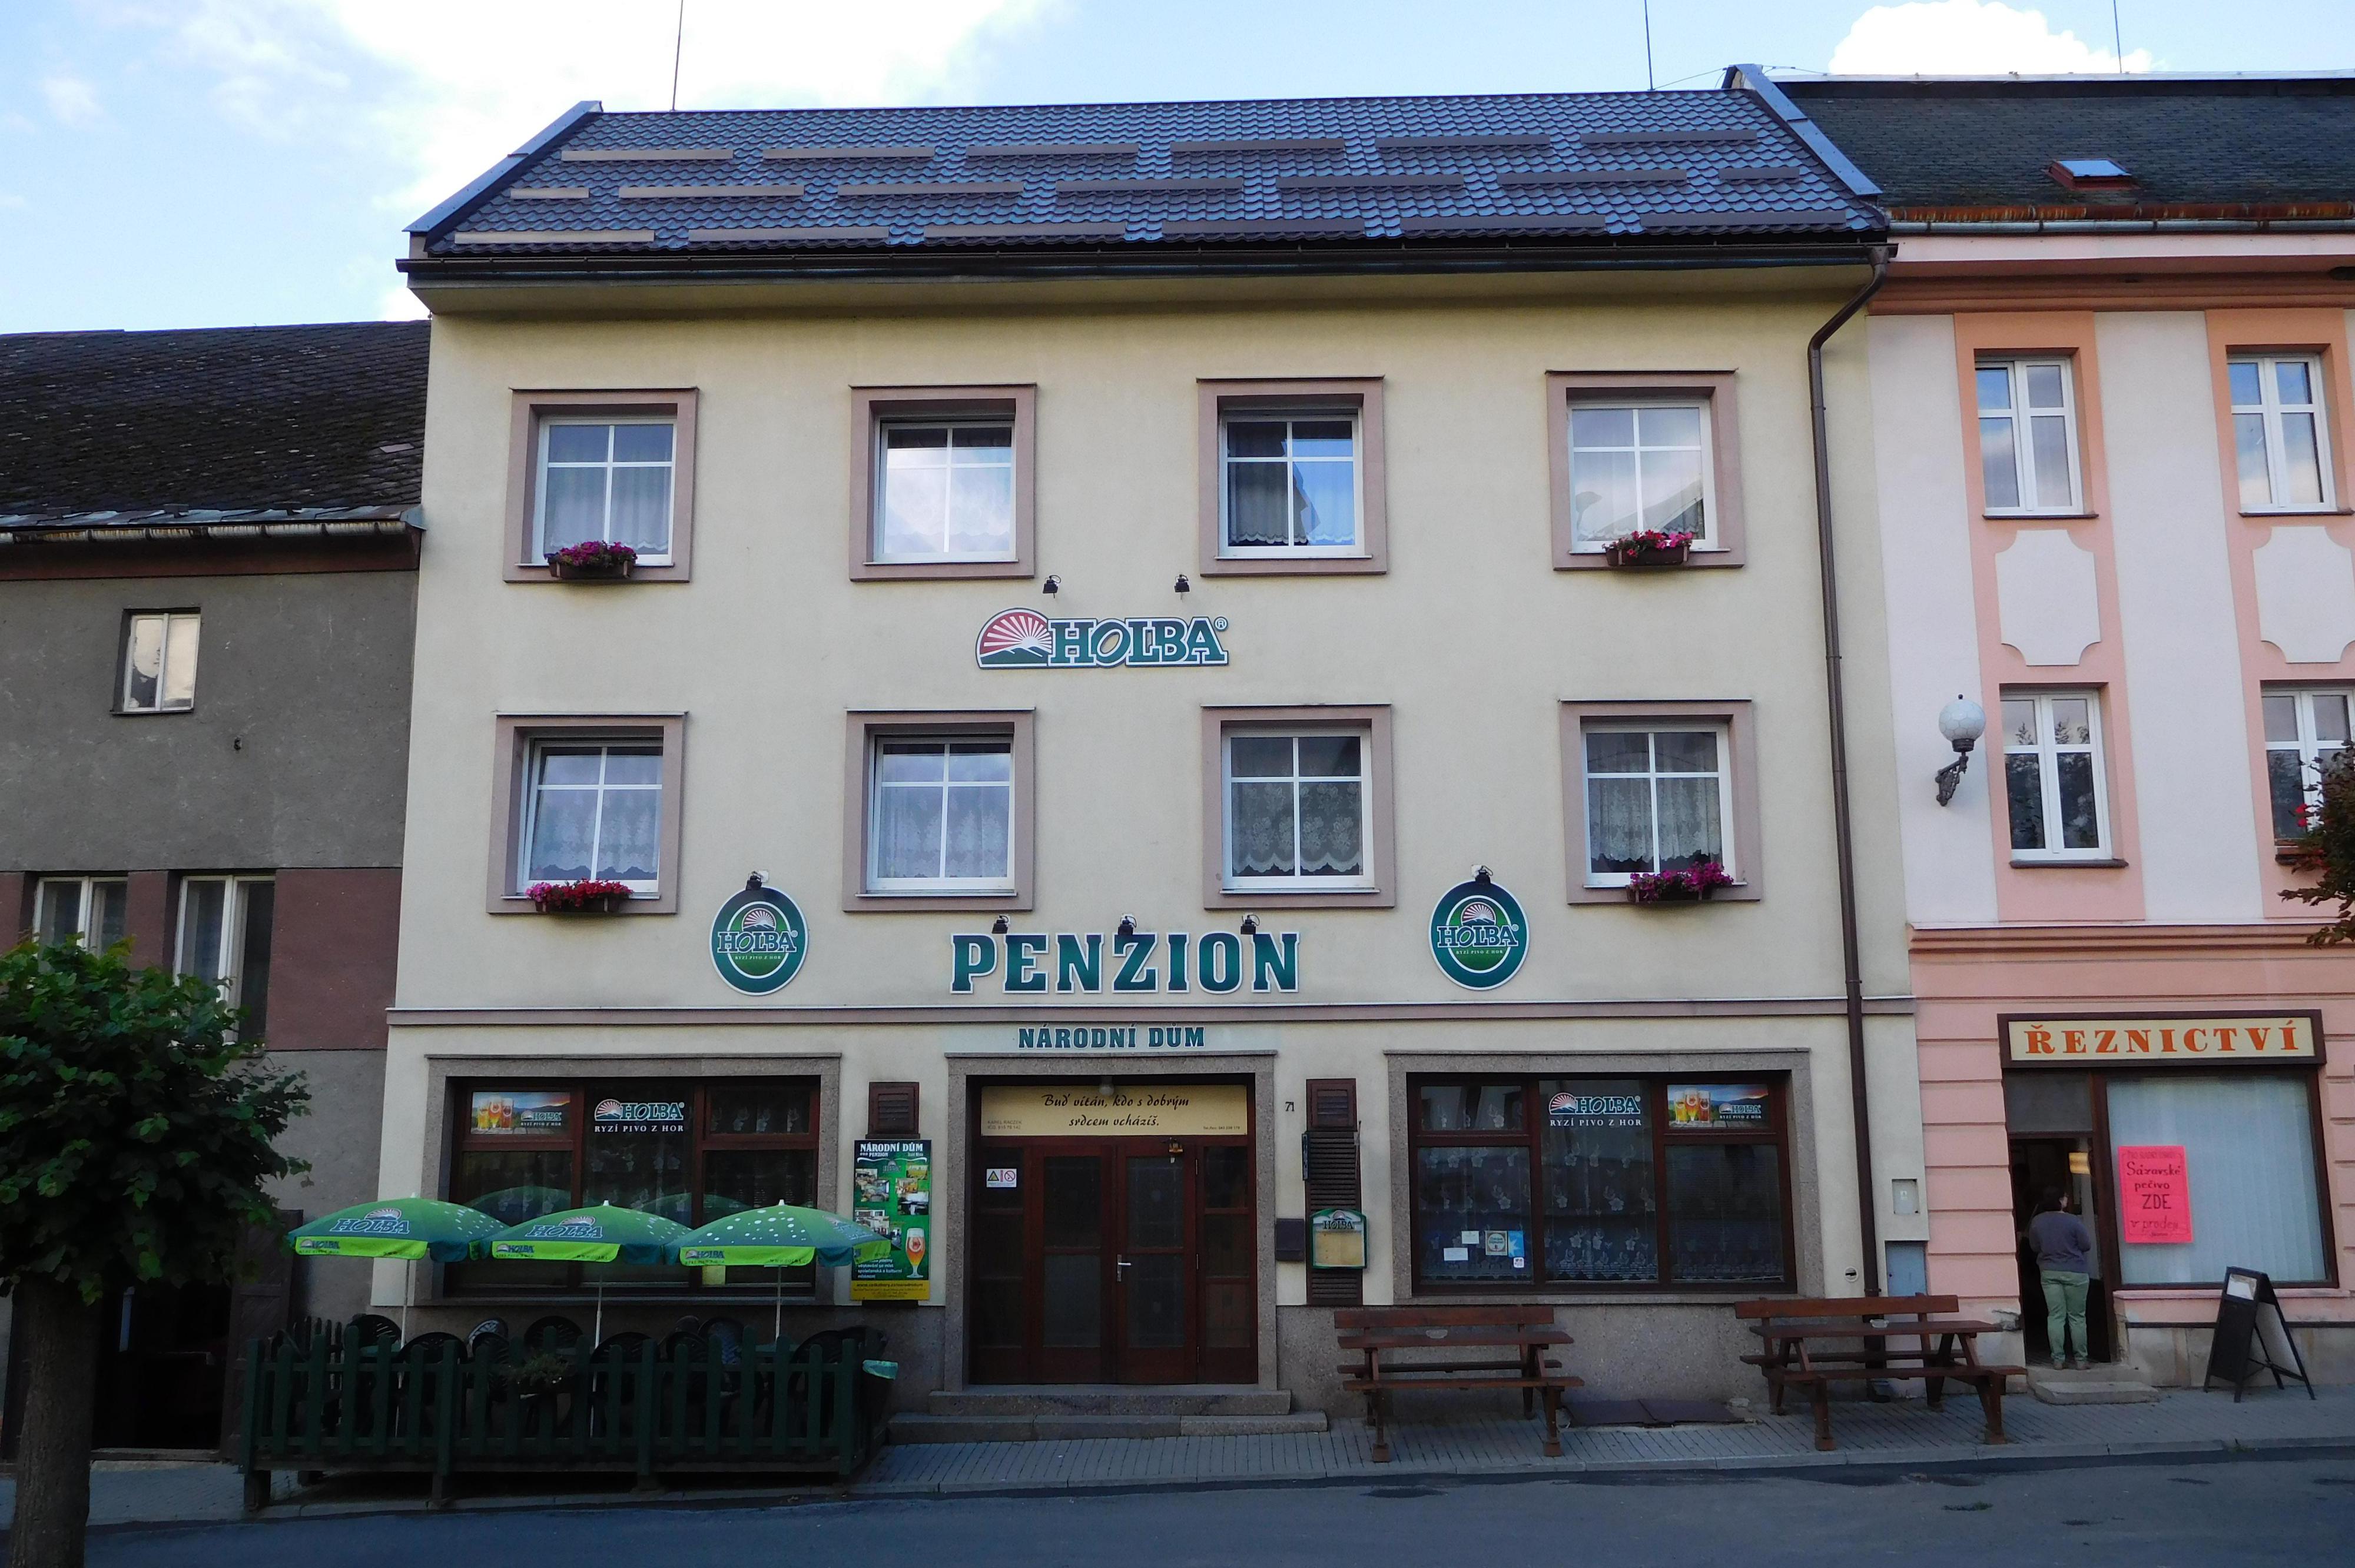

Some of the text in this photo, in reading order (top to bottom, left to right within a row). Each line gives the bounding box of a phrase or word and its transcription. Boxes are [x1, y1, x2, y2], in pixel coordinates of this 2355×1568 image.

[1048, 617, 1228, 667] HOLBA
[717, 931, 797, 953] HOLBA
[1437, 925, 1518, 948] HOLBA
[950, 932, 1299, 994] PENZION
[1019, 1023, 1205, 1048] NÁRODNÍ DŮM
[2024, 1019, 2299, 1054] ŘEZNICTVÍ
[1041, 1094, 1070, 1107] Buď
[1113, 1095, 1133, 1106] kdo
[1147, 1095, 1189, 1110] dobrým
[1285, 1101, 1295, 1112] 71
[1575, 1096, 1640, 1114] HOLBA
[1732, 1105, 1762, 1114] HOLBA
[533, 1112, 562, 1121] HOLBA
[620, 1102, 684, 1121] HOLBA
[1069, 1114, 1109, 1126] srdcem
[1550, 1118, 1574, 1126] RYZÍ
[860, 1142, 923, 1152] NÁRODNÍ DŮM
[2135, 1180, 2170, 1192] pečivo
[2142, 1194, 2171, 1209] ZDE
[330, 1218, 410, 1234] HOLBA
[525, 1225, 603, 1238] HOLBA
[1323, 1220, 1354, 1229] HOLBA
